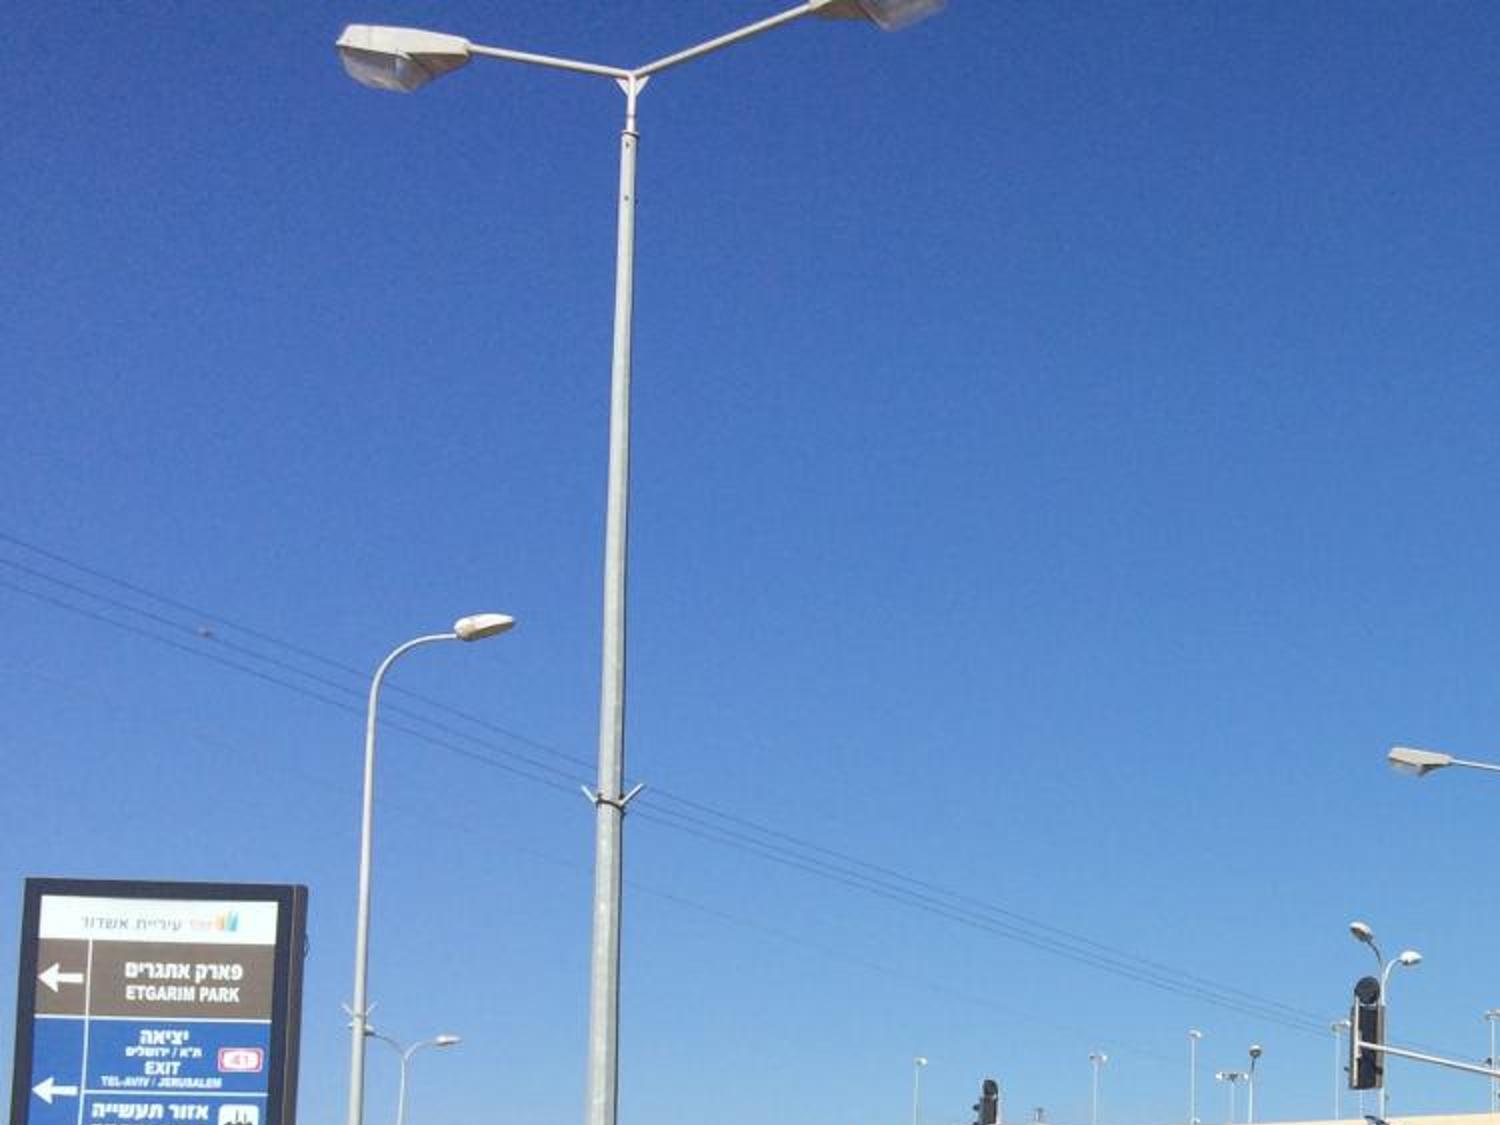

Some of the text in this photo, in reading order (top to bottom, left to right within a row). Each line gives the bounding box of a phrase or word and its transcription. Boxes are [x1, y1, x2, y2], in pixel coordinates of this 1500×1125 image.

[124, 961, 243, 983] פארק אתגרים
[126, 985, 240, 1003] ETGARIM PARK
[139, 1029, 189, 1045] יציאה
[144, 1061, 181, 1076] EXIT
[101, 1075, 149, 1088] TEL-AVIV
[157, 1077, 223, 1089] JERUSALEM
[91, 1103, 209, 1121] אזור תעשייה
